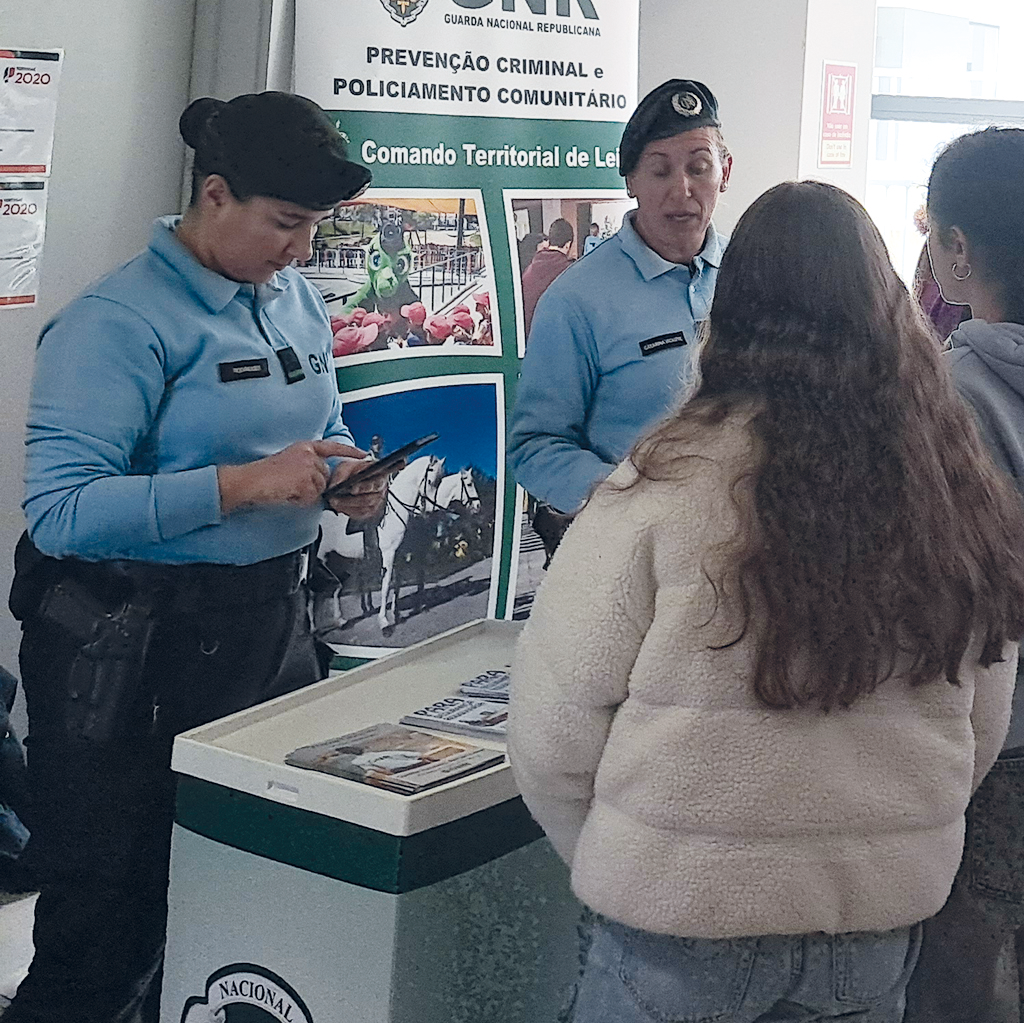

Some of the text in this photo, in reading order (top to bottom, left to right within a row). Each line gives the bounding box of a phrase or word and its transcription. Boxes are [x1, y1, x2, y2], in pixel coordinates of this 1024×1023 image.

[444, 13, 602, 37] GUARDA NACIONAL REPUBLICANA
[366, 46, 604, 79] PREVENÇÃO CRIMINAL e
[15, 72, 51, 85] 2020
[333, 77, 627, 109] POLICIAMENTO COMUNITÁRIO
[361, 139, 457, 165] Comando
[462, 143, 559, 167] Territorial
[565, 145, 590, 168] de
[2, 203, 37, 215] 2020
[308, 352, 329, 374] GN
[219, 979, 293, 1023] NACIONAL
